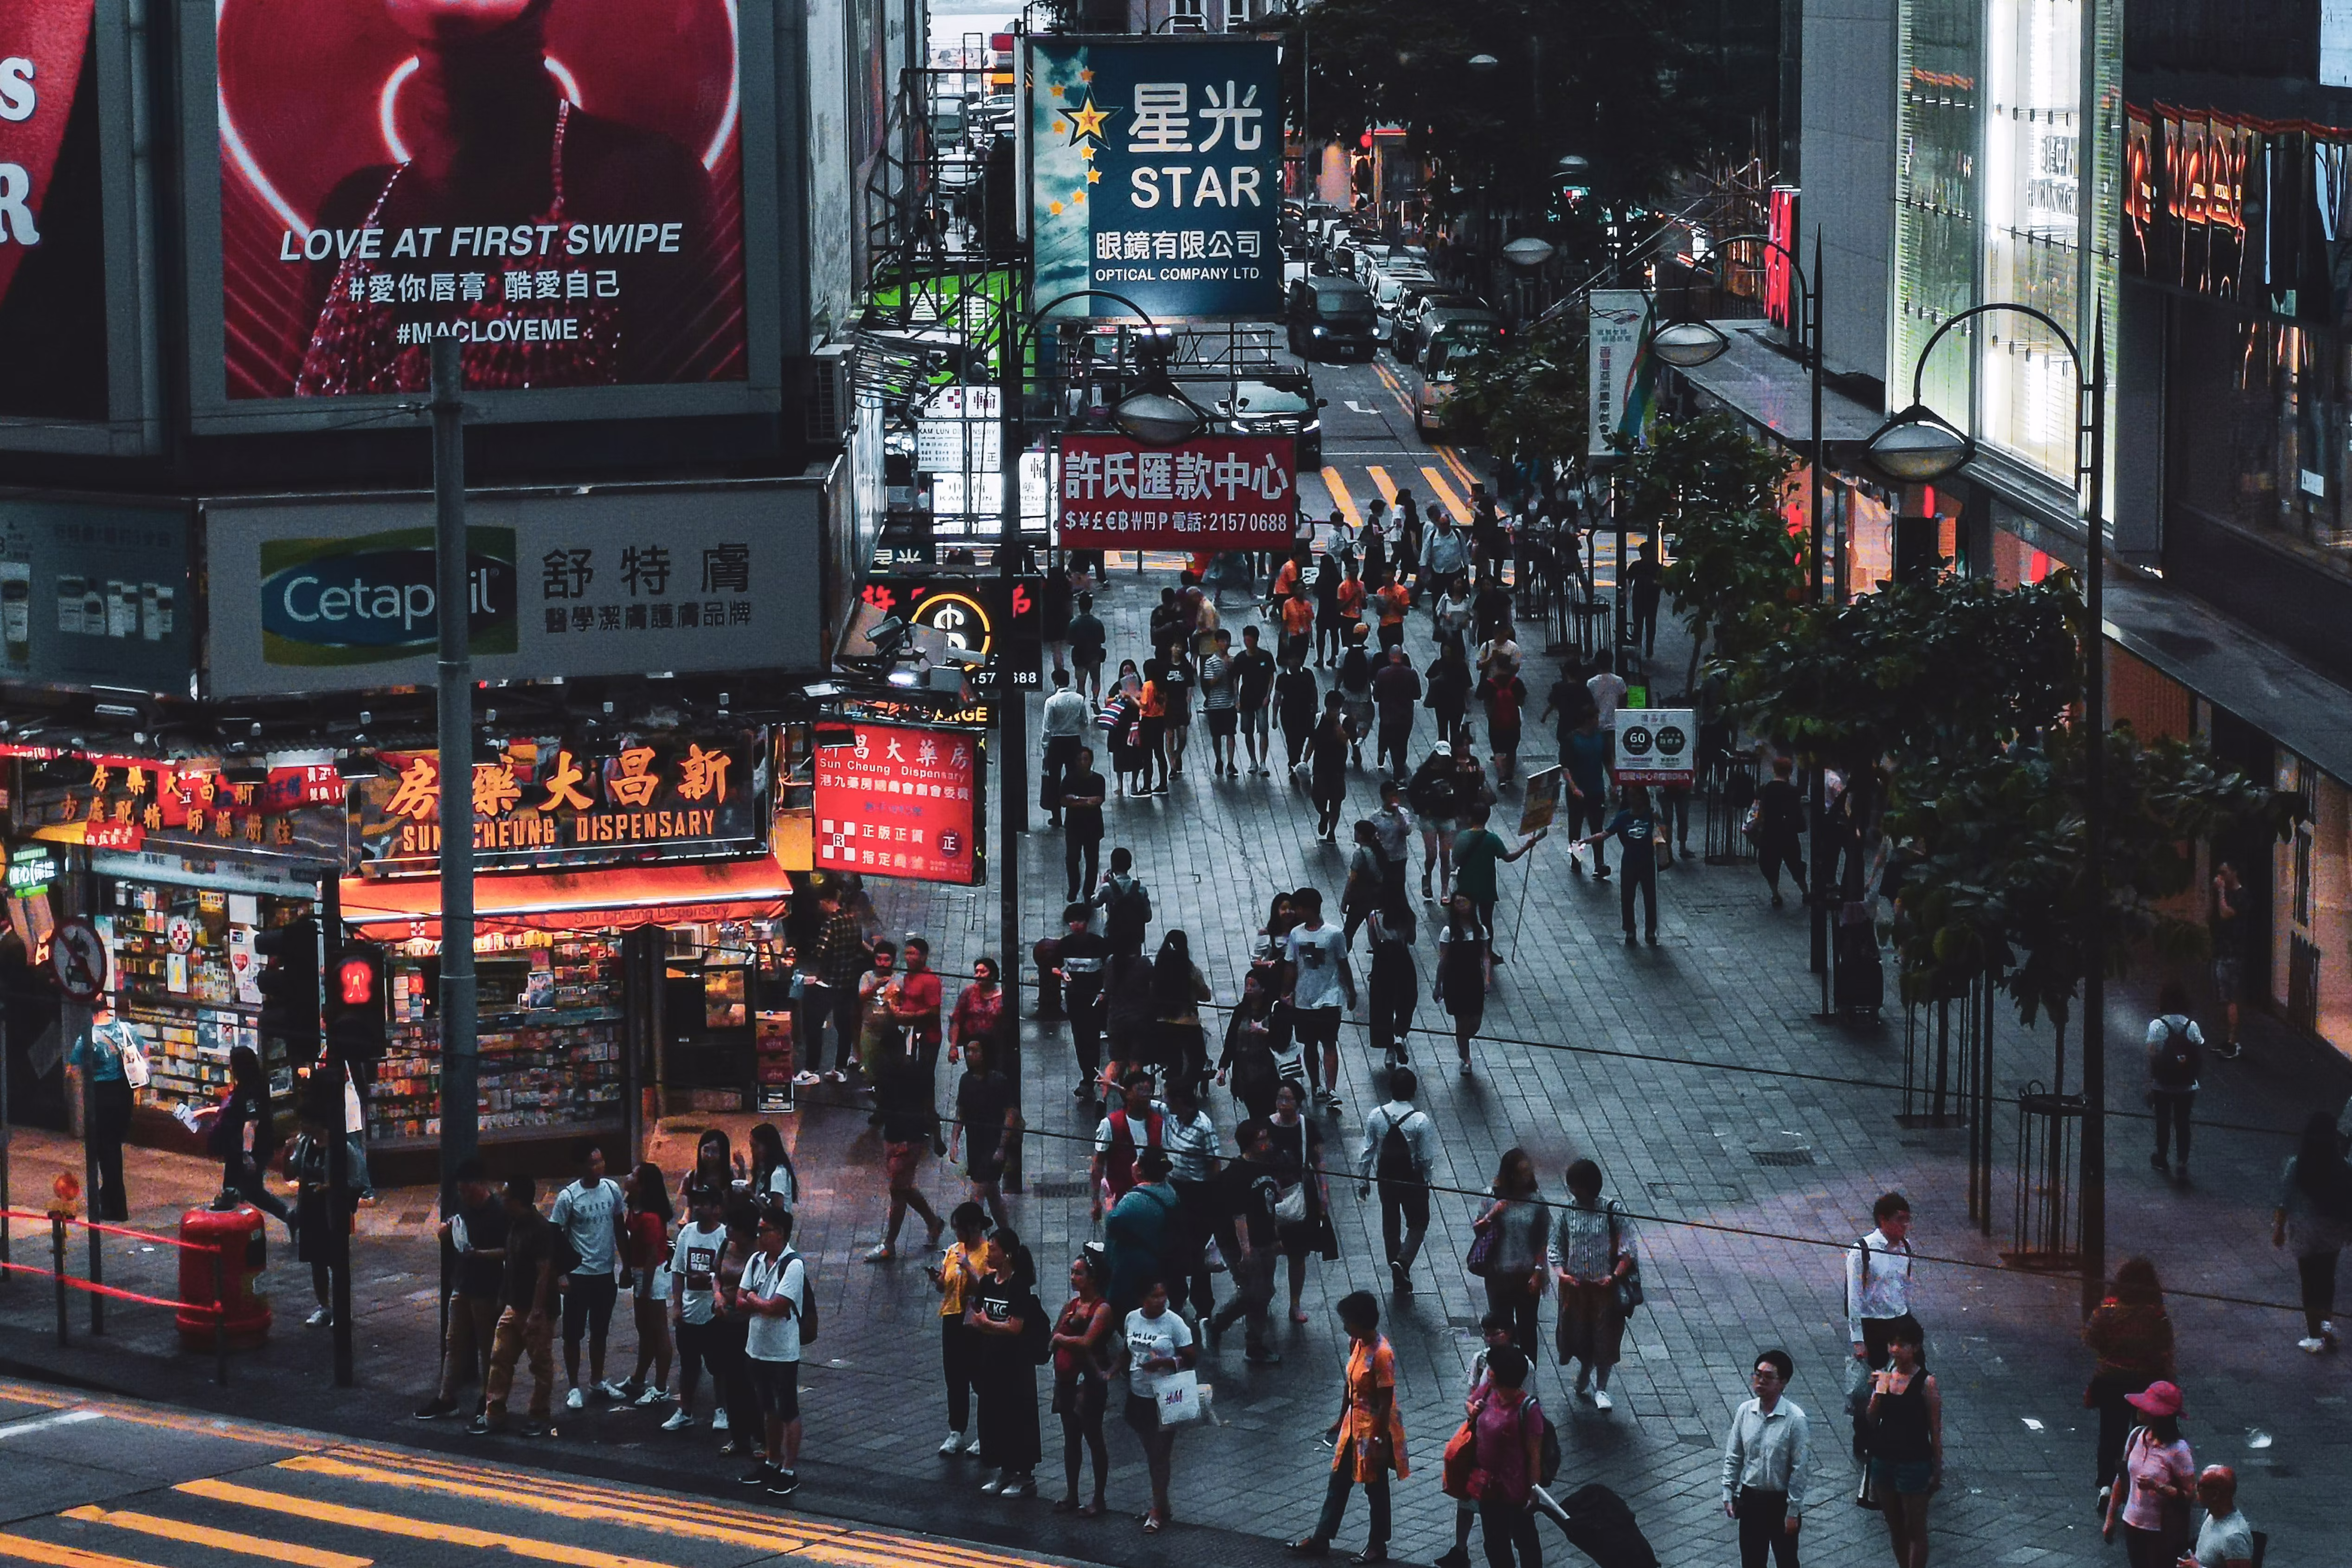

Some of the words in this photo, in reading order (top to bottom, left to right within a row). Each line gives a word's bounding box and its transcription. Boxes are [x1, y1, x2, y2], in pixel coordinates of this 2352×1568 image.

[1128, 80, 1262, 153] 星光
[1131, 166, 1260, 208] STAR
[280, 228, 384, 261] LOVE
[391, 227, 442, 258] AT
[450, 225, 559, 257] FIRST
[565, 223, 683, 255] SWIPE
[1096, 230, 1260, 260] 眼鏡有限公司
[349, 272, 486, 303] #愛你唇膏
[505, 270, 620, 299] 酷愛自己
[1095, 268, 1156, 281] OPTICAL
[1160, 267, 1228, 281] COMPANY
[397, 319, 578, 345] #MACLOVEME
[1065, 451, 1288, 501] 許氏匯款中心
[543, 542, 750, 600] 舒特膚
[283, 567, 495, 630] Cetapil
[820, 758, 841, 769] Sun
[847, 760, 890, 776] Cheung
[901, 766, 965, 783] Dispensary
[403, 825, 441, 852] SUN
[577, 809, 714, 842] DISPENSARY
[942, 836, 956, 850] 正
